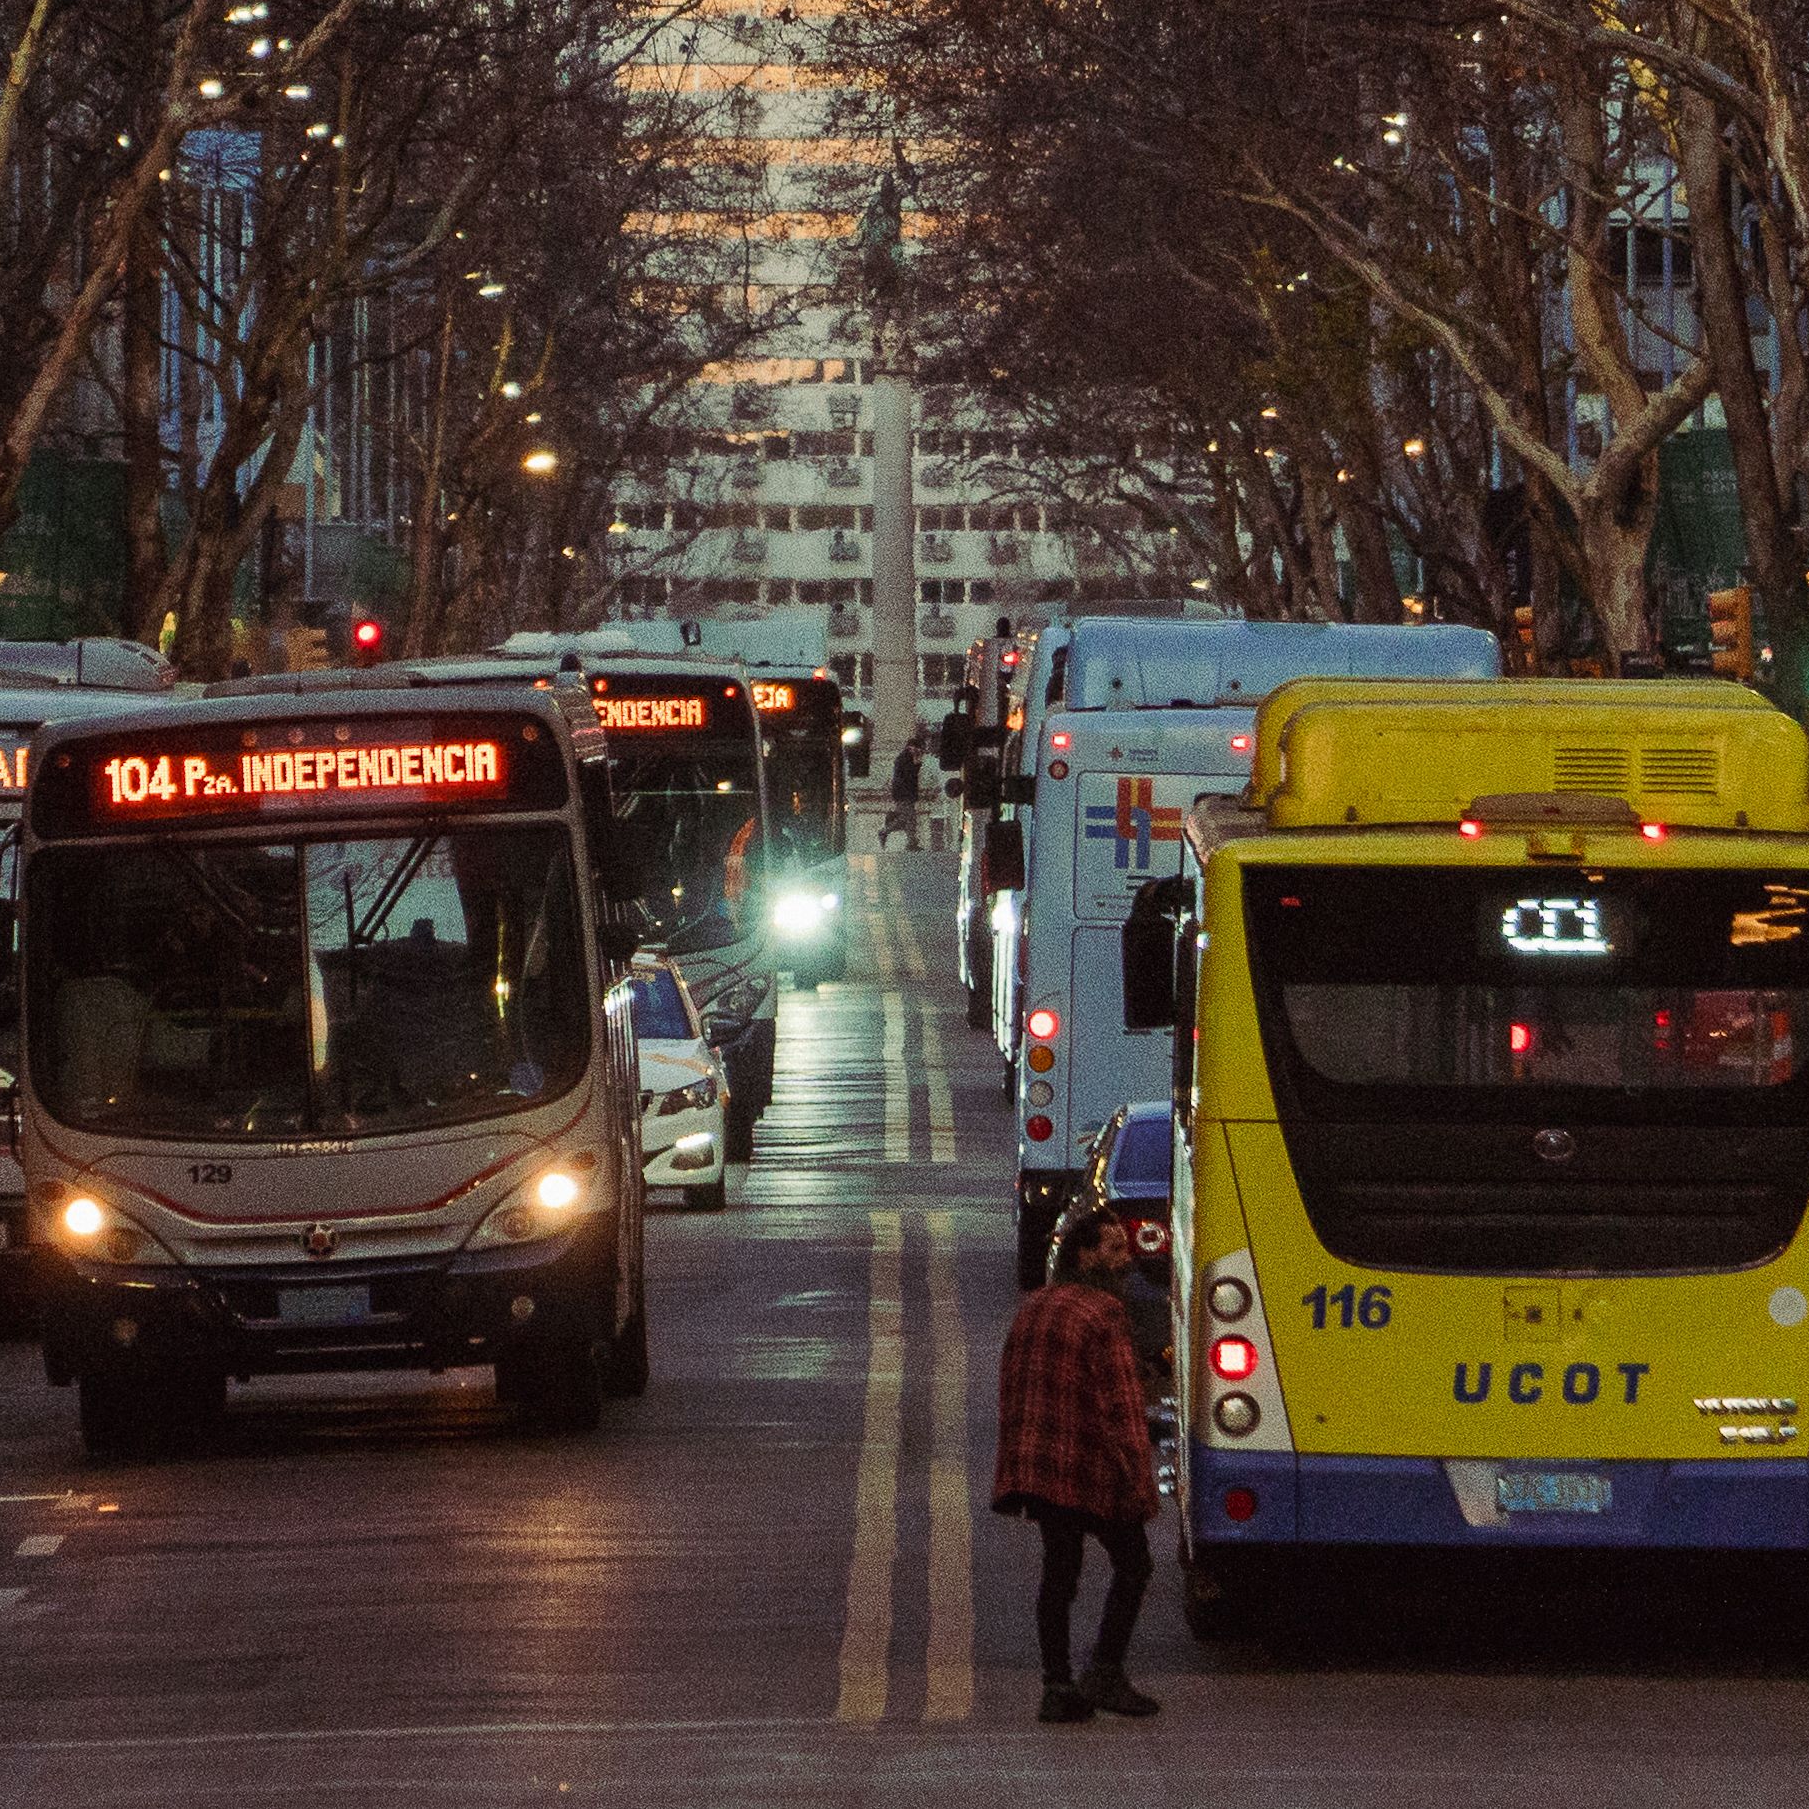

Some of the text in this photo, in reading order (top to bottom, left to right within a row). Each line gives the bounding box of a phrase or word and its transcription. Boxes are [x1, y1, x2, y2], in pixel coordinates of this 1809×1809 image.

[104, 756, 177, 803] 104
[242, 744, 496, 793] INDEPENDENCIA
[188, 1164, 233, 1184] 129
[1301, 1285, 1394, 1330] 116
[1452, 1362, 1650, 1406] UCOT
